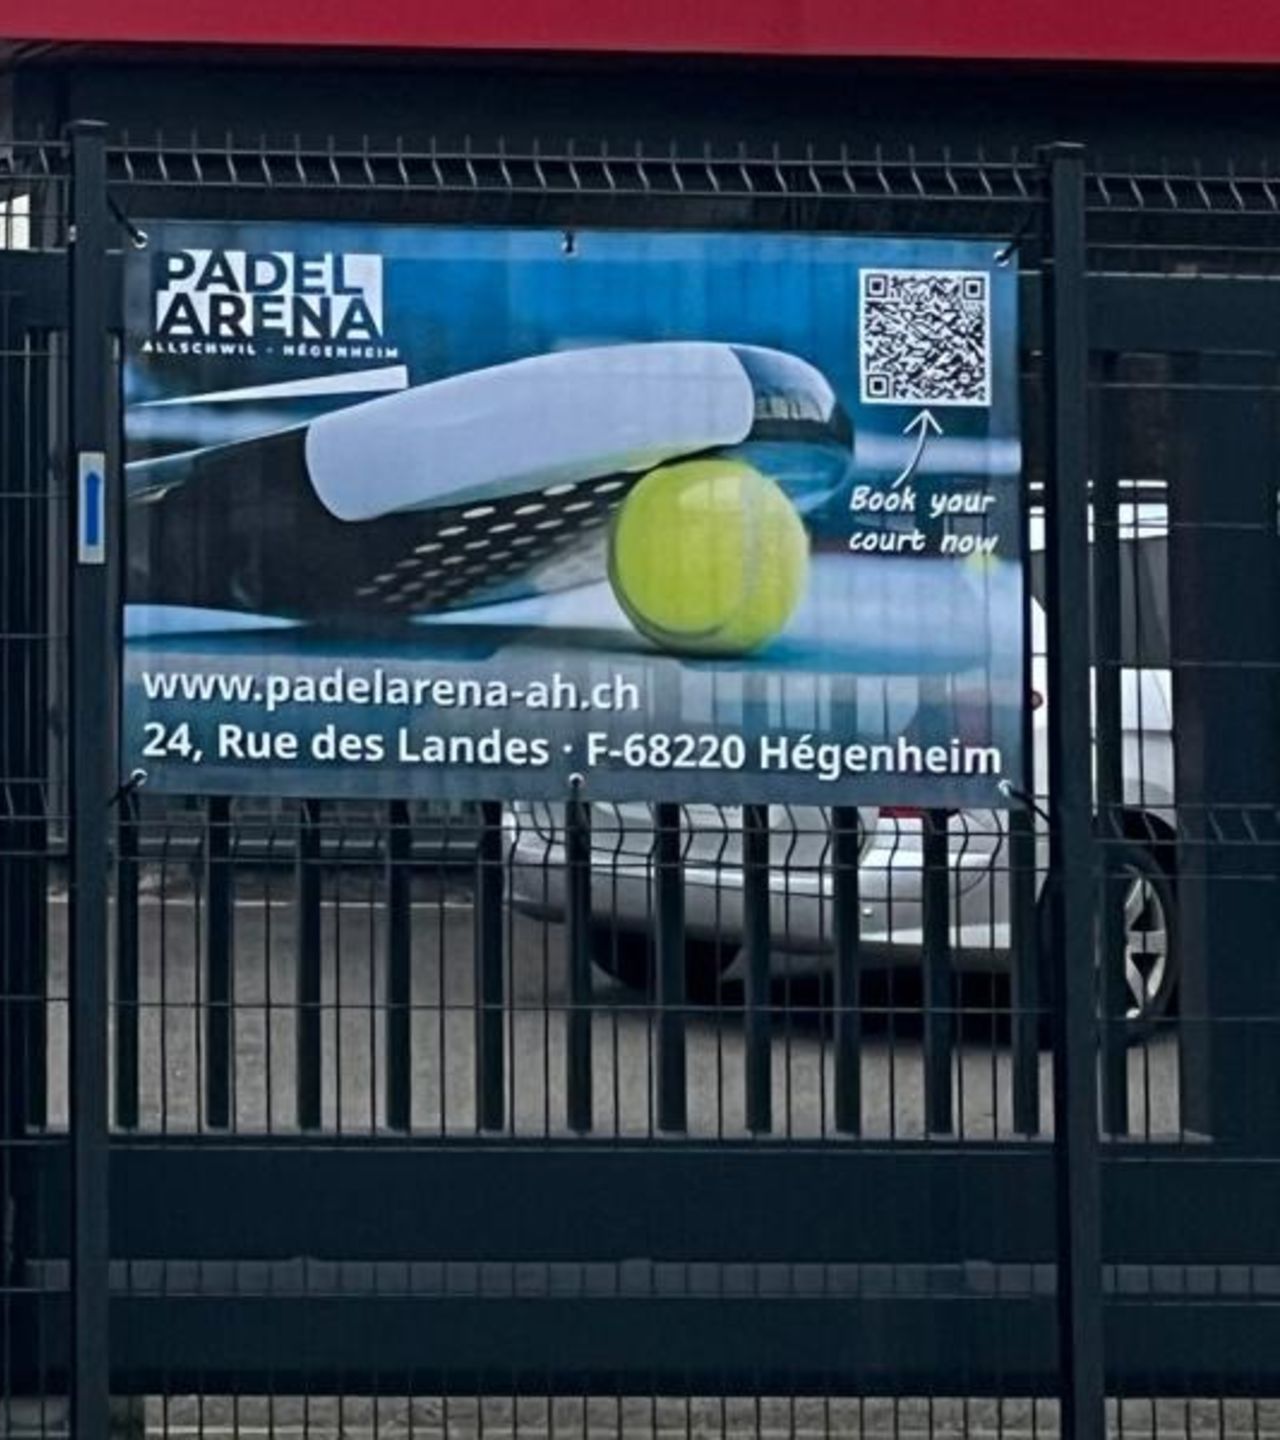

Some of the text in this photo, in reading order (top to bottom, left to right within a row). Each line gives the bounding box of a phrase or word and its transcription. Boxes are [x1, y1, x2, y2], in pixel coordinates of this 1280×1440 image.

[157, 250, 364, 295] PADEL
[156, 293, 383, 339] ARENA
[141, 340, 257, 356] ALLSCHWIL
[848, 484, 996, 520] Book your
[848, 528, 1000, 554] court now
[142, 667, 641, 712] www.padelarena-ah.ch
[142, 721, 203, 764] 24,
[217, 723, 298, 760] Rue
[311, 723, 385, 761] des
[398, 727, 550, 766] Landes
[587, 730, 747, 769] F-68220
[759, 732, 1002, 783] Hégenheim
